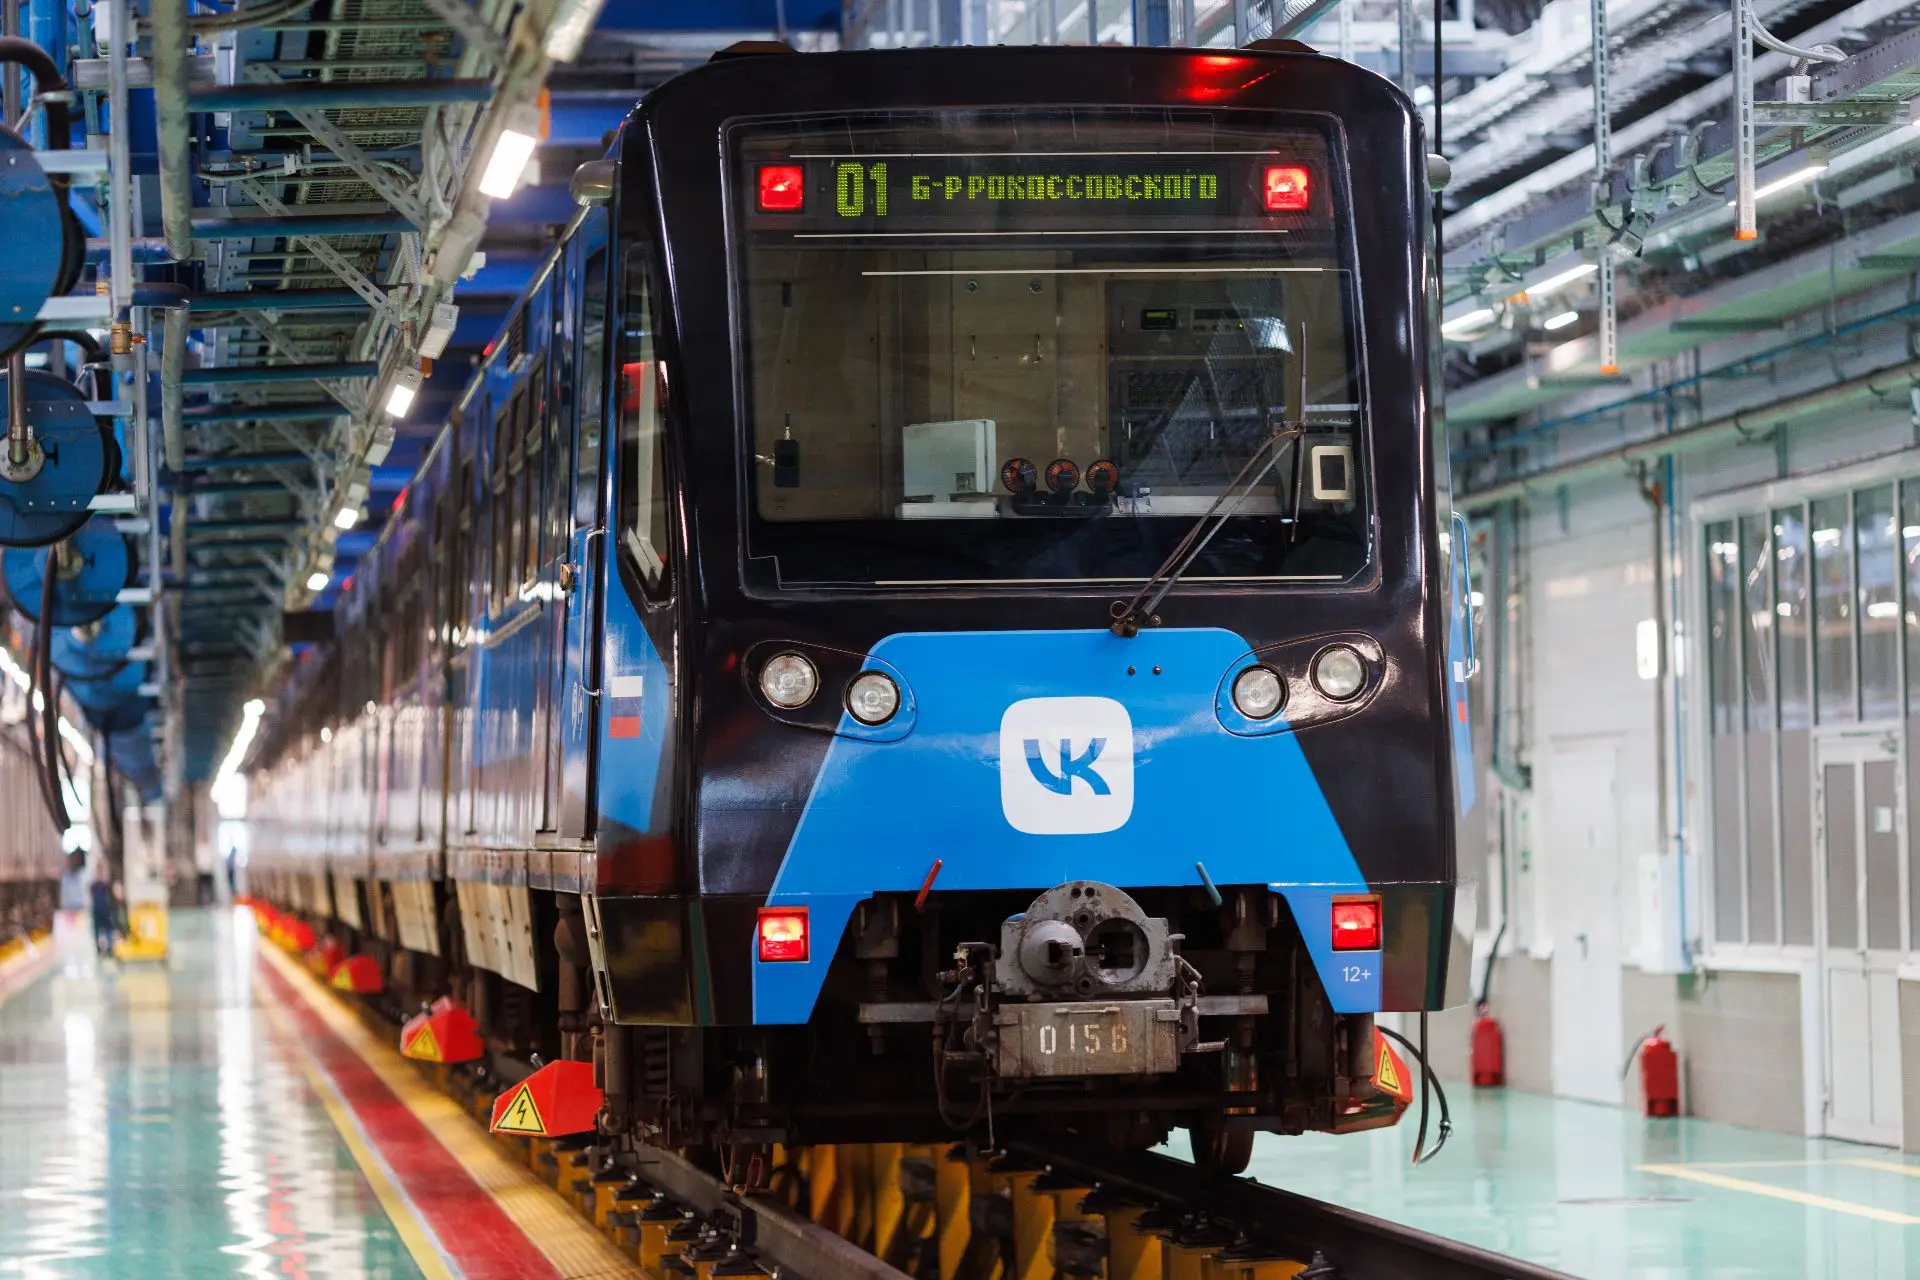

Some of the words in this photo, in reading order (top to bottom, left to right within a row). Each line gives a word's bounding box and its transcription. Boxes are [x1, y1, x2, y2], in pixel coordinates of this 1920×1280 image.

[835, 162, 887, 217] 01
[967, 174, 1217, 200] РОКОССОВСКОГО
[1022, 737, 1112, 796] VK
[1342, 966, 1371, 982] 12+
[1039, 1023, 1128, 1055] 0156
